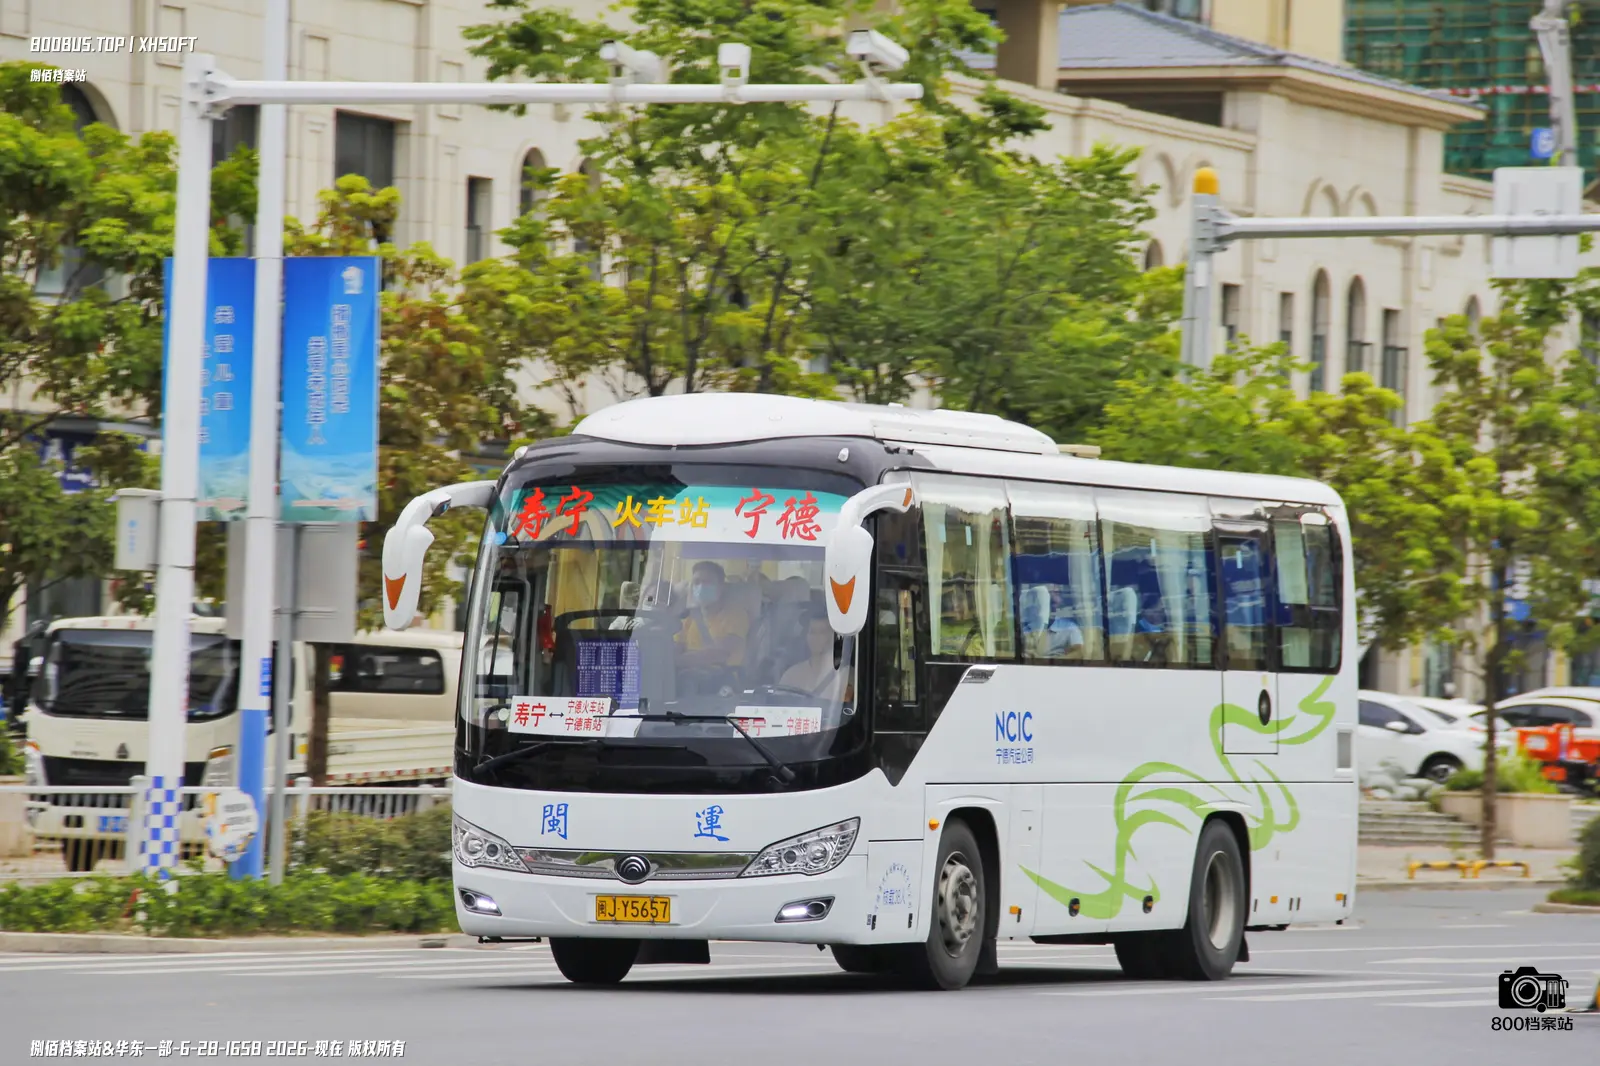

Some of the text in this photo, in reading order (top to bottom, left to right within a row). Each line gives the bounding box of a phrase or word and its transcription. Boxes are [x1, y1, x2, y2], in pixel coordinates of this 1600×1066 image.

[512, 486, 822, 541] 寿宁 火车站 宁德
[514, 702, 546, 727] 寿宁
[568, 700, 604, 714] 宁德火车站
[565, 716, 602, 732] 宁德南站
[995, 711, 1033, 742] NCIC
[996, 748, 1033, 765] 宁德汽运公司
